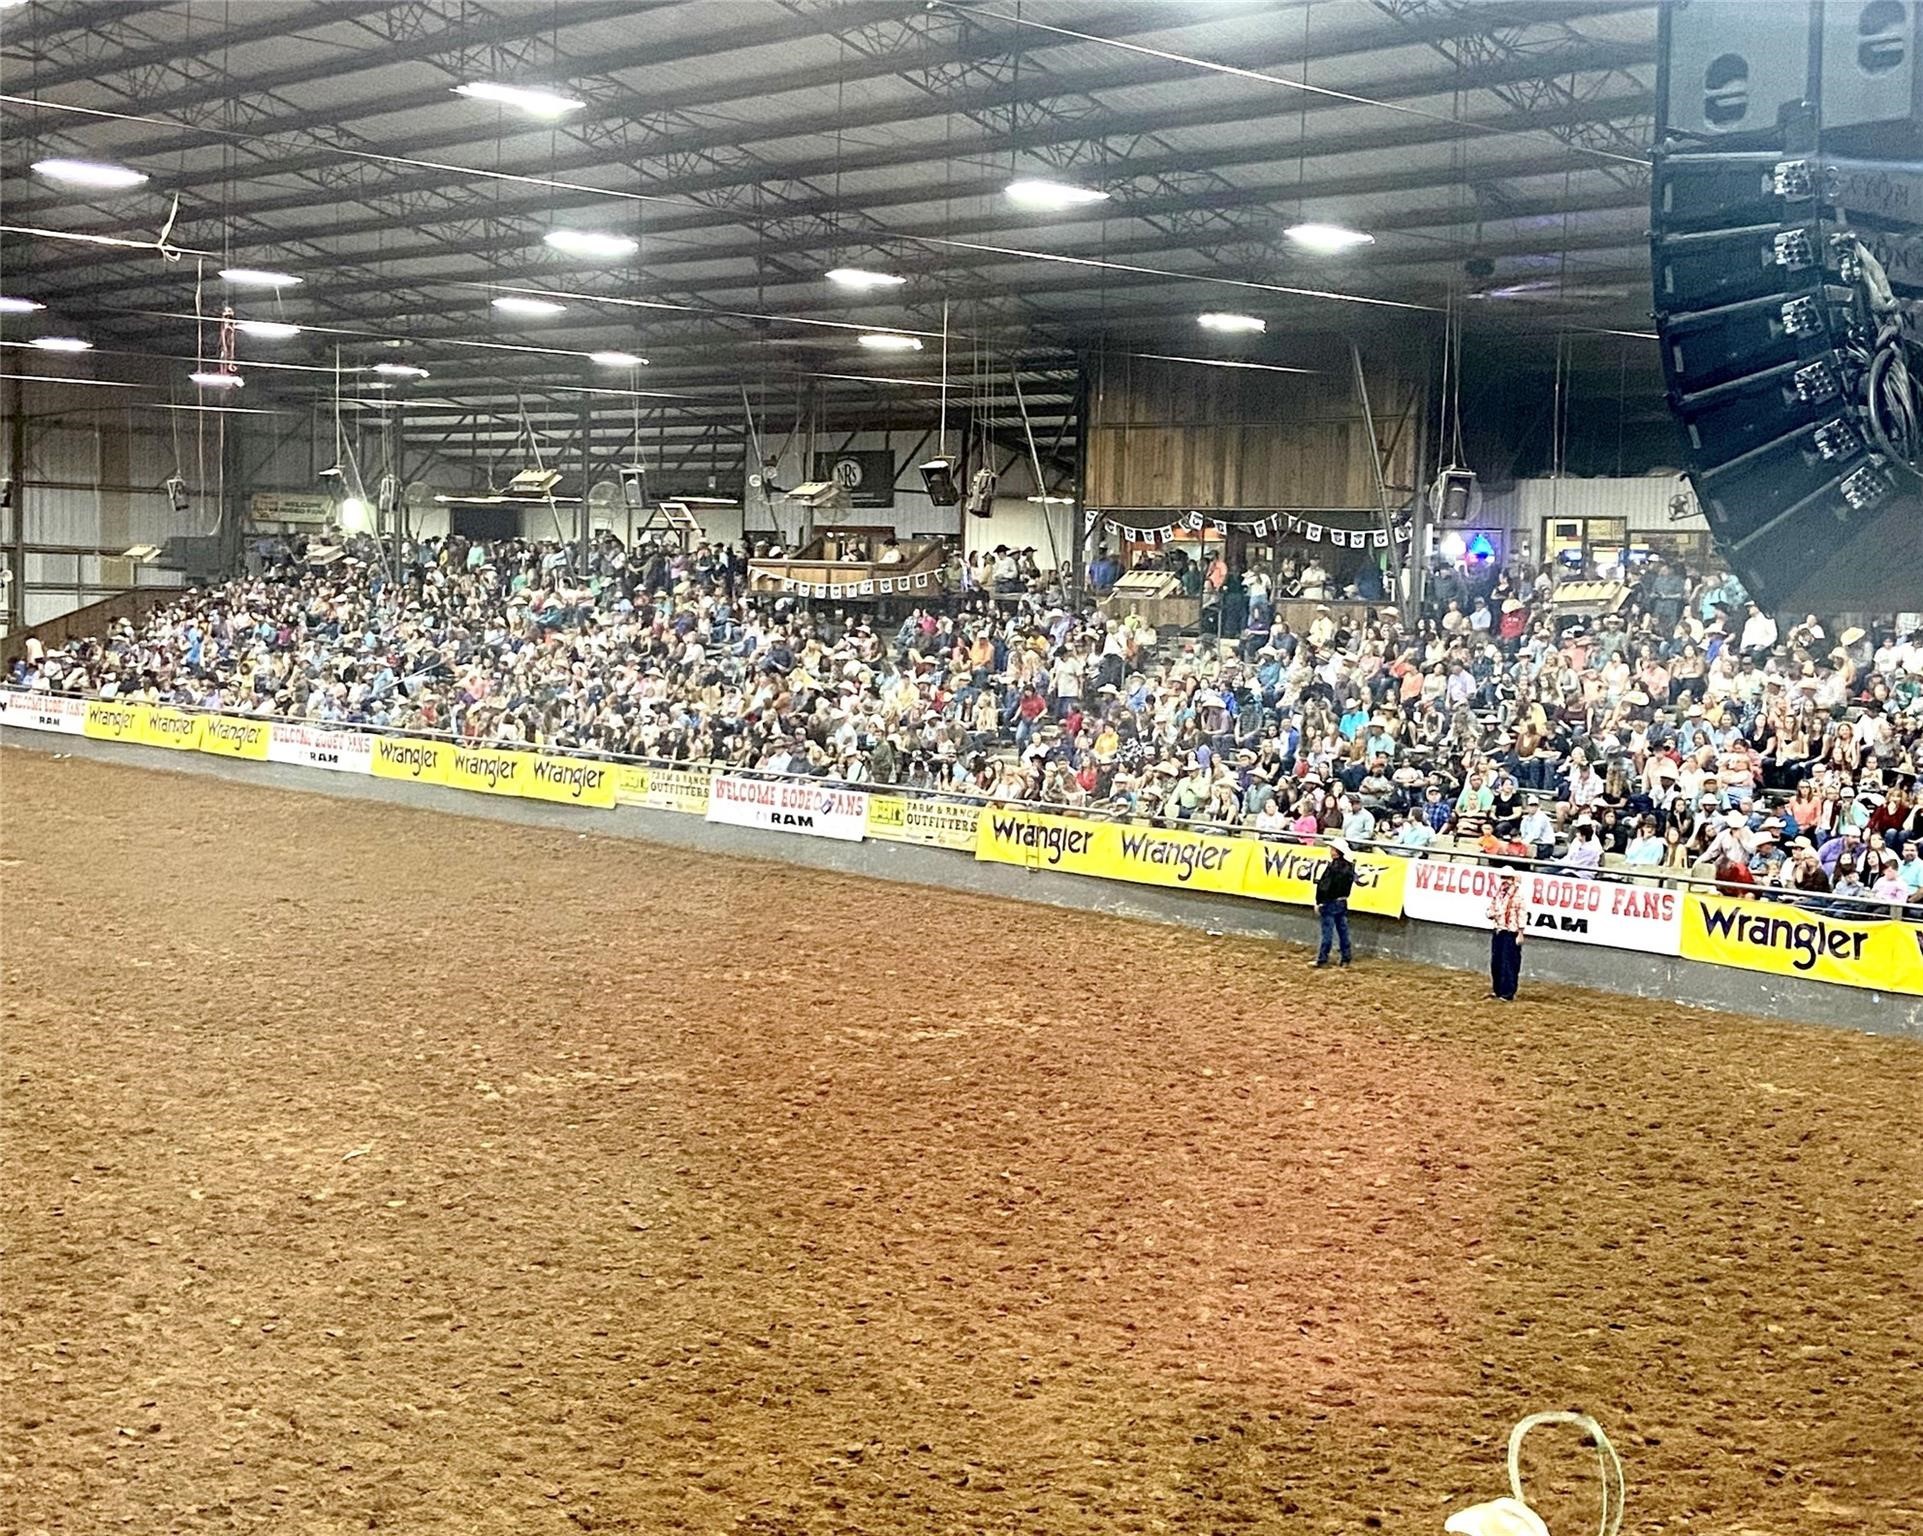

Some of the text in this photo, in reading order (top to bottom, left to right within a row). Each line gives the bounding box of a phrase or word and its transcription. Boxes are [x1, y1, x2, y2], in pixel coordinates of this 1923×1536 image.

[39, 716, 60, 726] RAM
[88, 705, 263, 751] Wrangler Wrangler Wrangler
[310, 751, 339, 763] RAM
[379, 740, 438, 777] Wrangler
[452, 749, 518, 788] Wrangler
[533, 758, 606, 797] Wrangler
[650, 781, 709, 798] OUTFITTERS
[716, 779, 776, 806] WELCOME
[781, 788, 823, 811] RODEO
[830, 793, 864, 816] FANS
[771, 812, 814, 827] RAM
[906, 802, 934, 813] FARM
[946, 806, 981, 819] RANCH
[906, 813, 978, 833] OUTFITTERS
[992, 814, 1095, 865] Wrangler
[1121, 829, 1233, 882] Wrangler
[1532, 878, 1602, 912] RODEO
[1612, 887, 1675, 922] FANS
[1700, 901, 1869, 971] Wrangler
